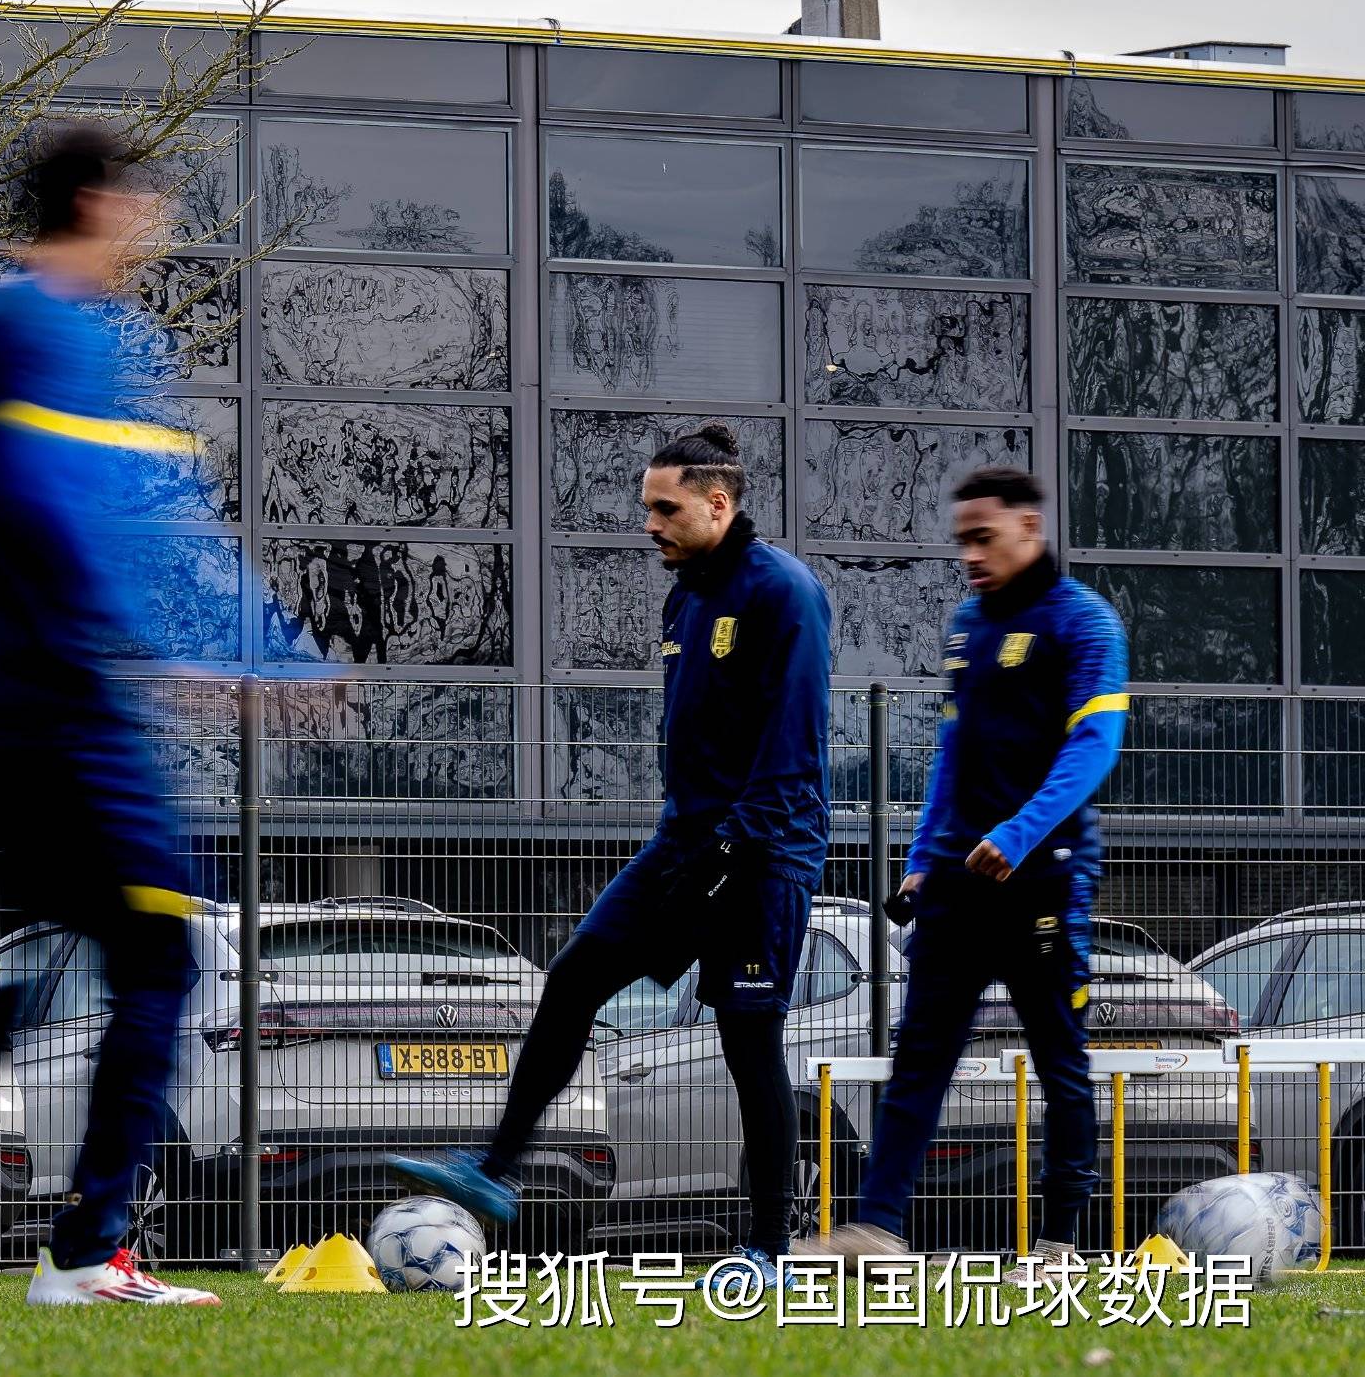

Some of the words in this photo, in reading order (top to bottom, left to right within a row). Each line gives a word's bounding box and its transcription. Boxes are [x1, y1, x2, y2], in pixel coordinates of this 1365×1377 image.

[745, 964, 760, 974] 11
[398, 1048, 498, 1069] X-888-BT
[1255, 1217, 1276, 1284] DERBYS
